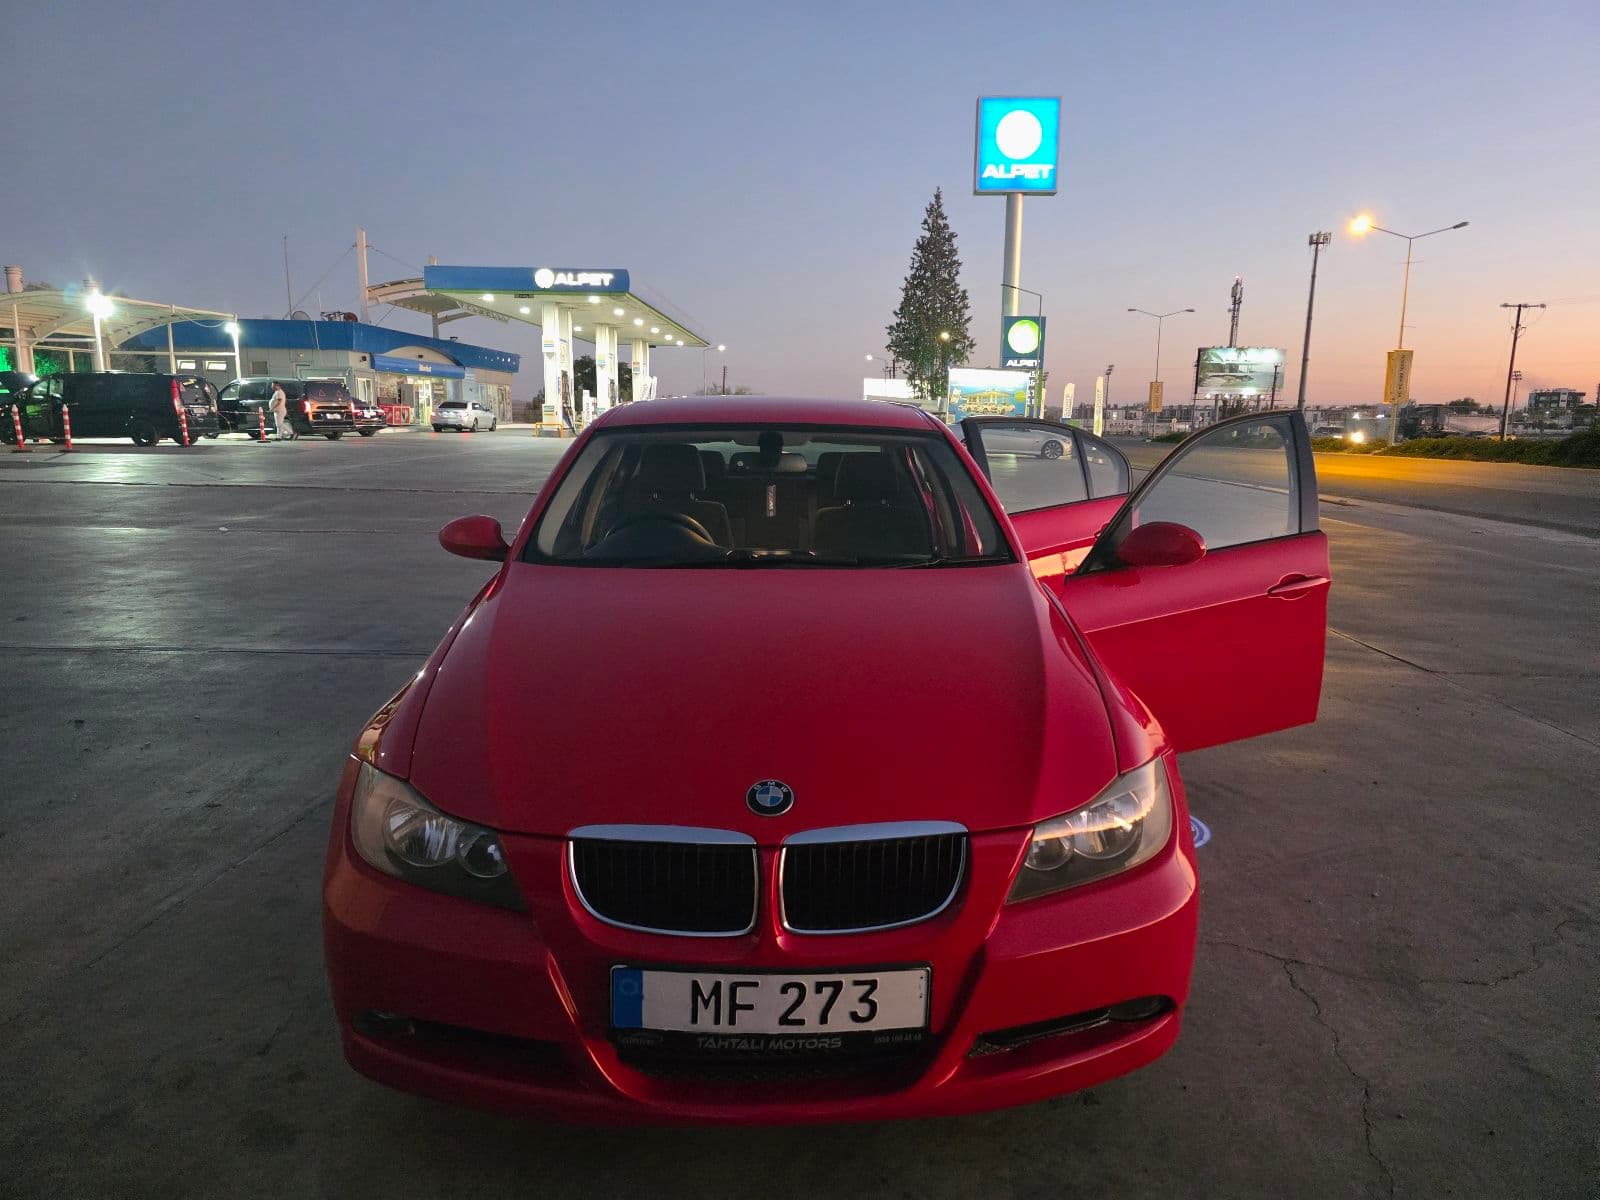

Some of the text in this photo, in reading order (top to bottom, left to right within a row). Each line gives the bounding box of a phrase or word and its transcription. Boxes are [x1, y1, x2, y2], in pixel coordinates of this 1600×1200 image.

[982, 164, 1053, 179] ALPET
[554, 272, 613, 286] ALPET
[753, 781, 789, 793] BMW
[691, 979, 879, 1026] MF 273
[697, 1037, 842, 1050] TAHTALI MOTORS
